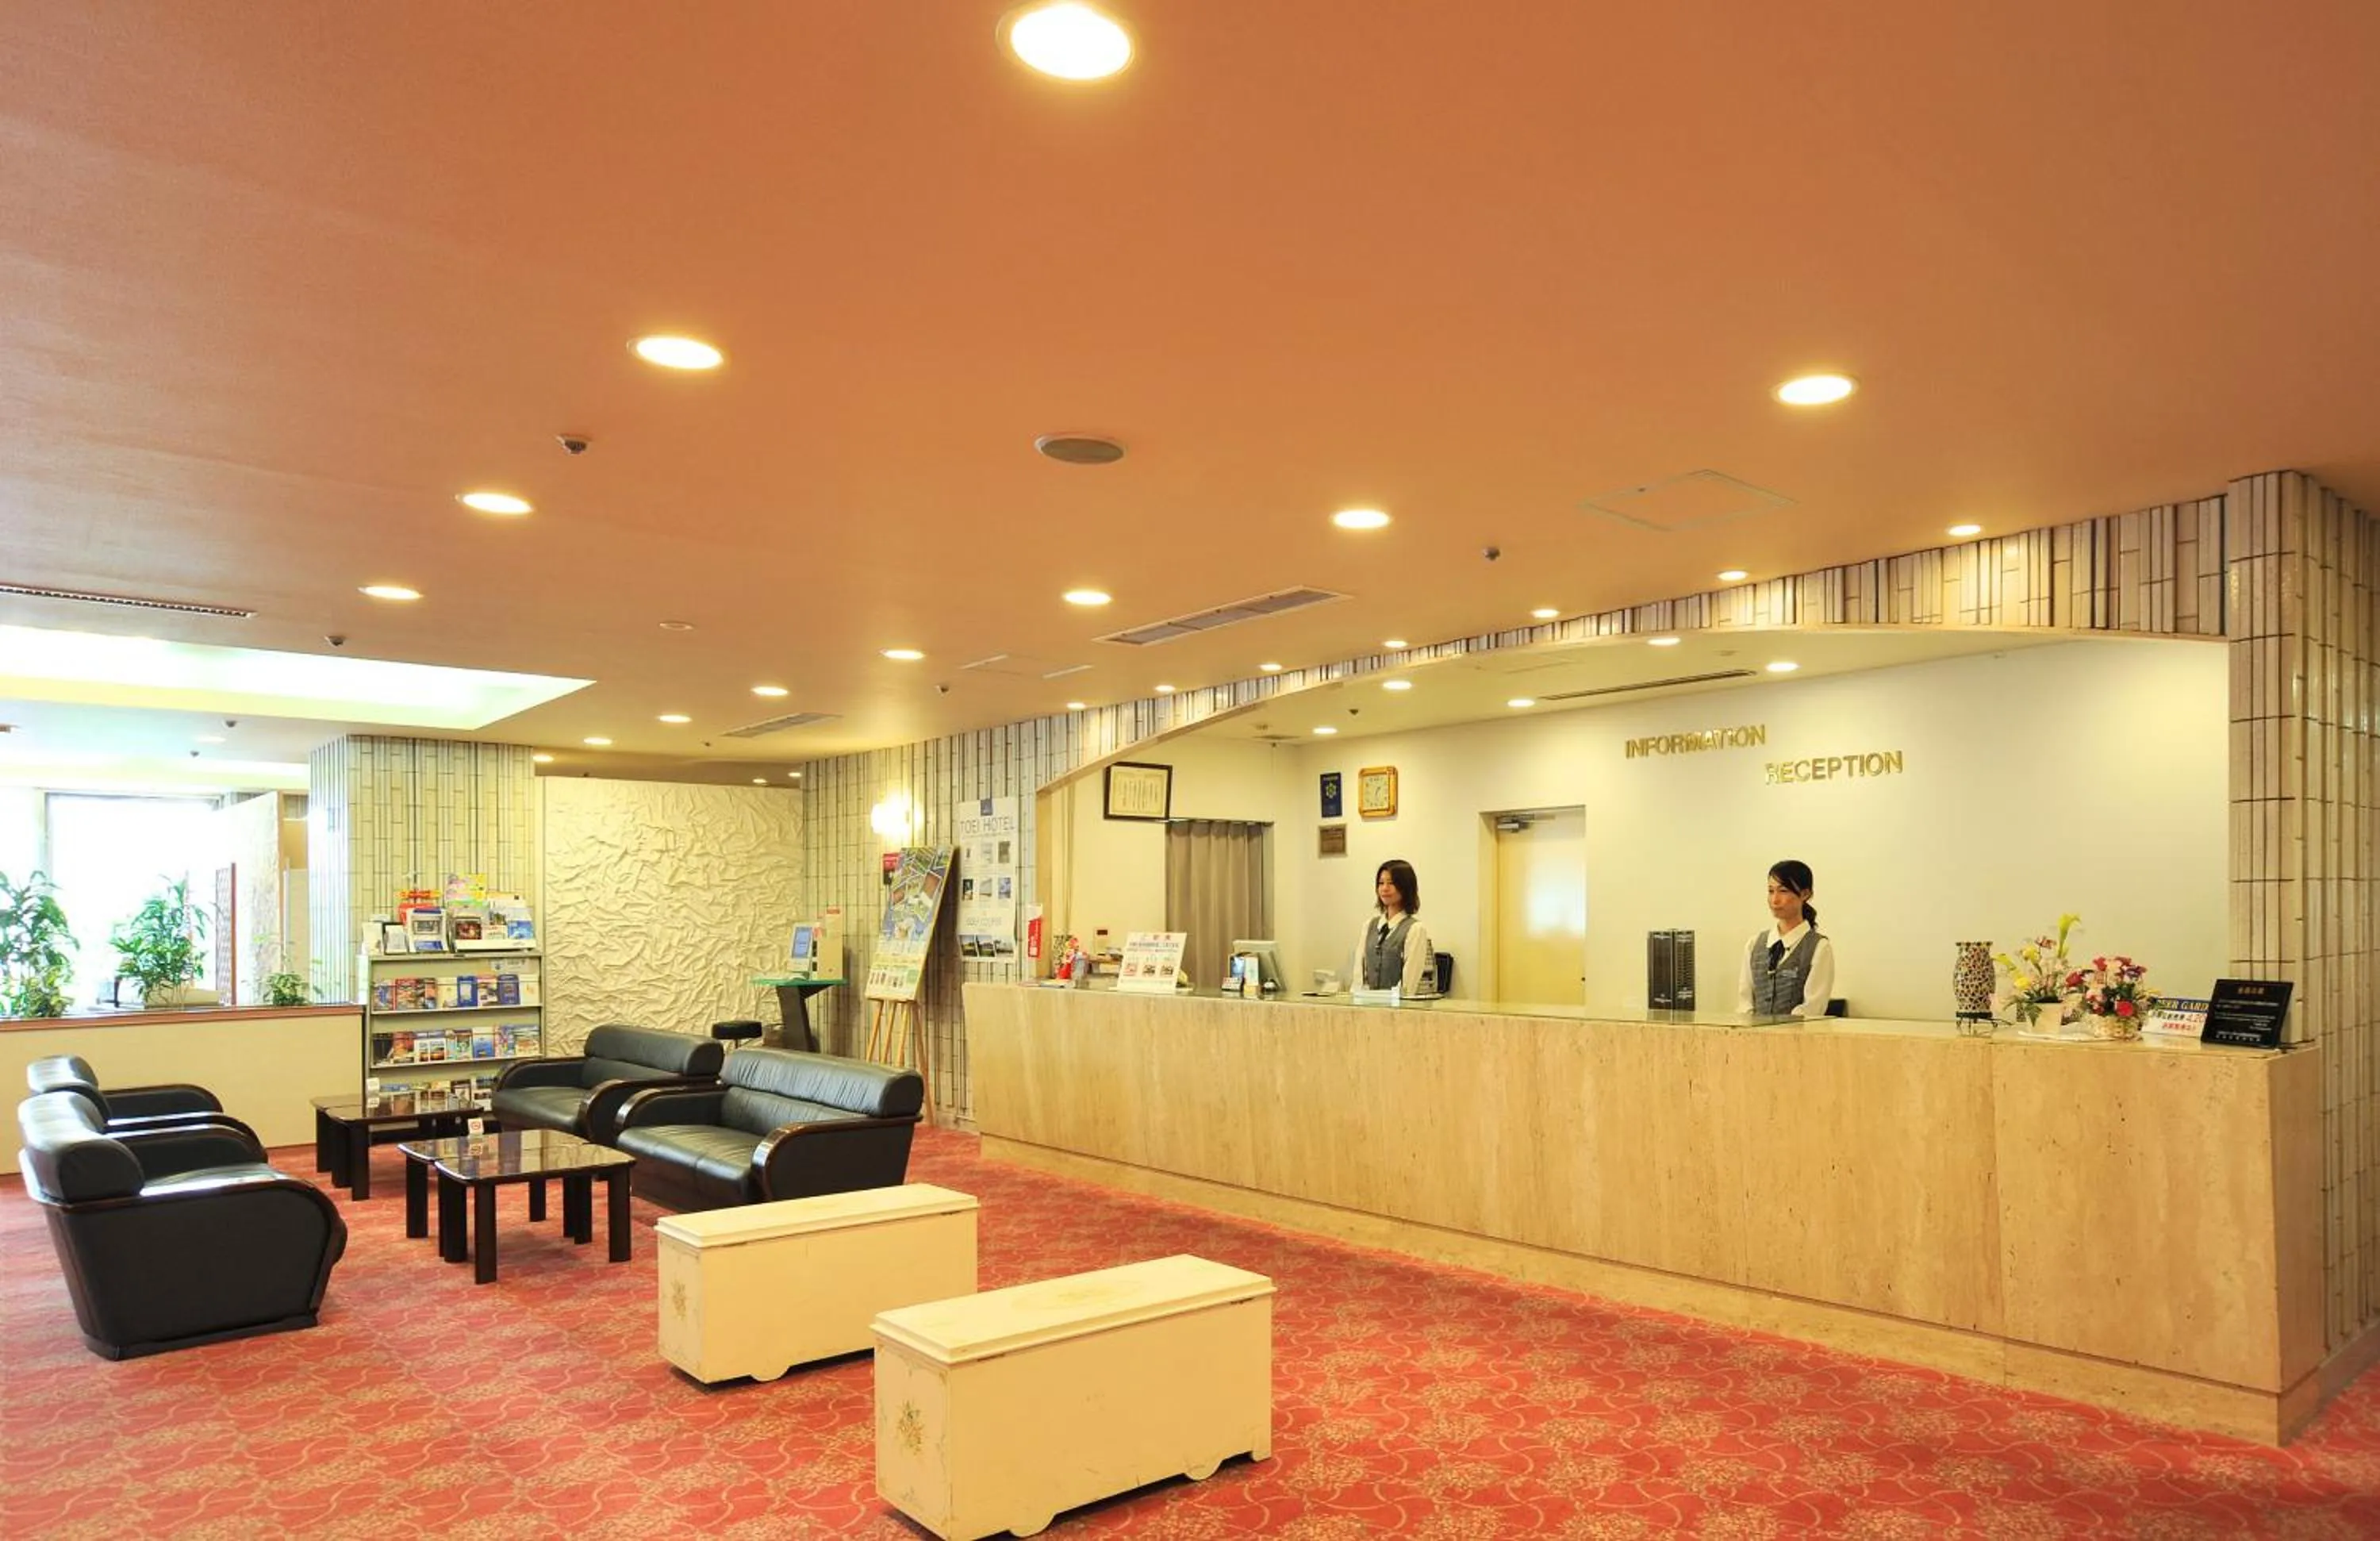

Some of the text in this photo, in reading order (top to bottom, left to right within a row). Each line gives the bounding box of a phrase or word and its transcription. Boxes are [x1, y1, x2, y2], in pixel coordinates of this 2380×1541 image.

[1625, 724, 1766, 759] INFORMATION
[1764, 750, 1904, 786] RECEPTION
[960, 816, 1015, 834] TOEI HOTEL
[2181, 1001, 2209, 1012] GARD
